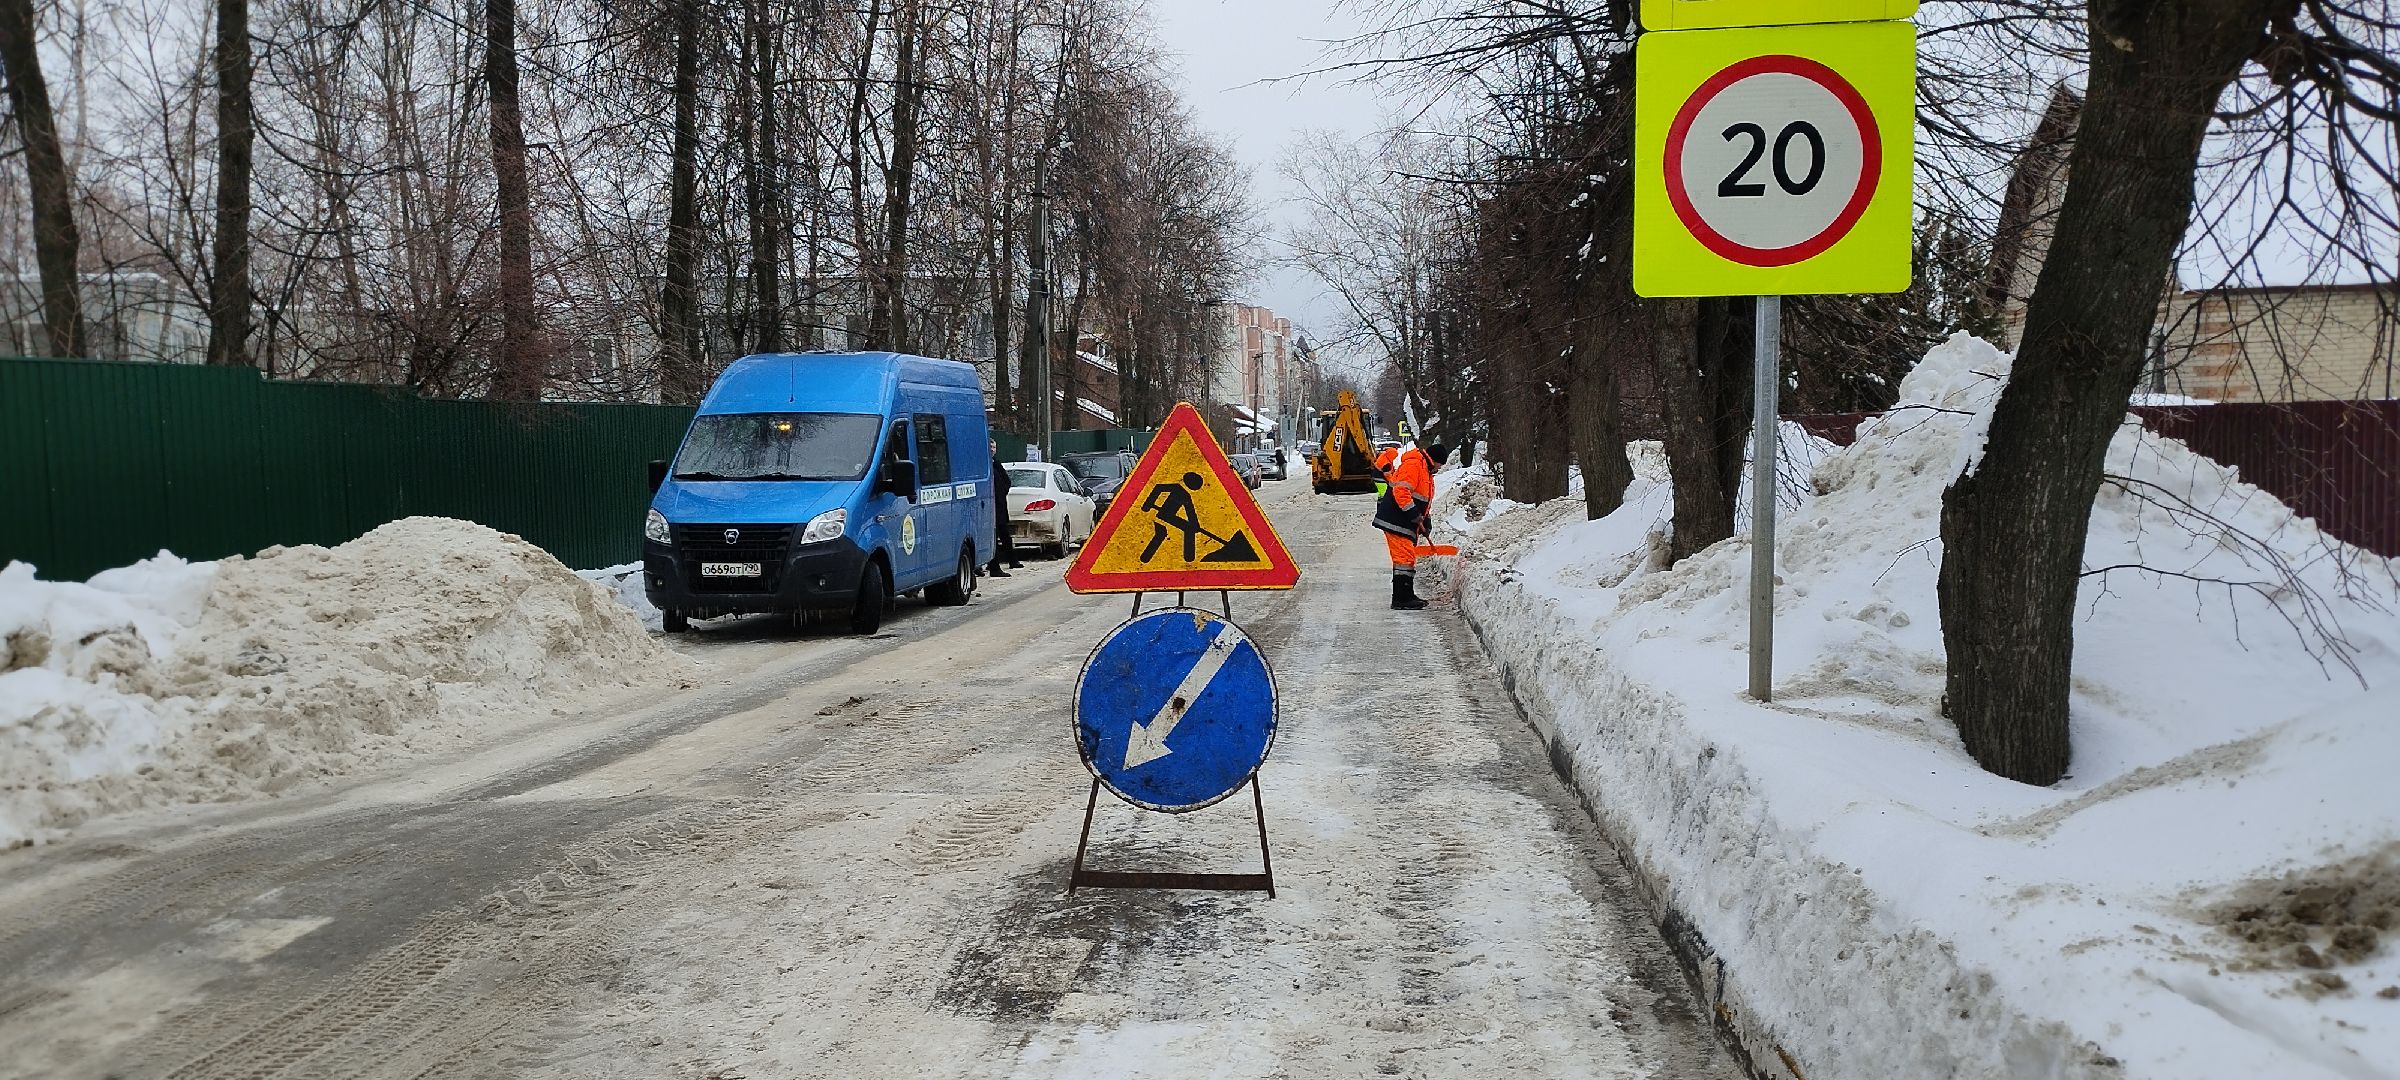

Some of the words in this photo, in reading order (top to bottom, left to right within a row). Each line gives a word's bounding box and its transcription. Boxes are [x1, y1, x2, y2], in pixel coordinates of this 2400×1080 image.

[1717, 120, 1826, 197] 20
[1334, 427, 1343, 452] JCB
[922, 488, 951, 501] ДОРОЖНАЯ
